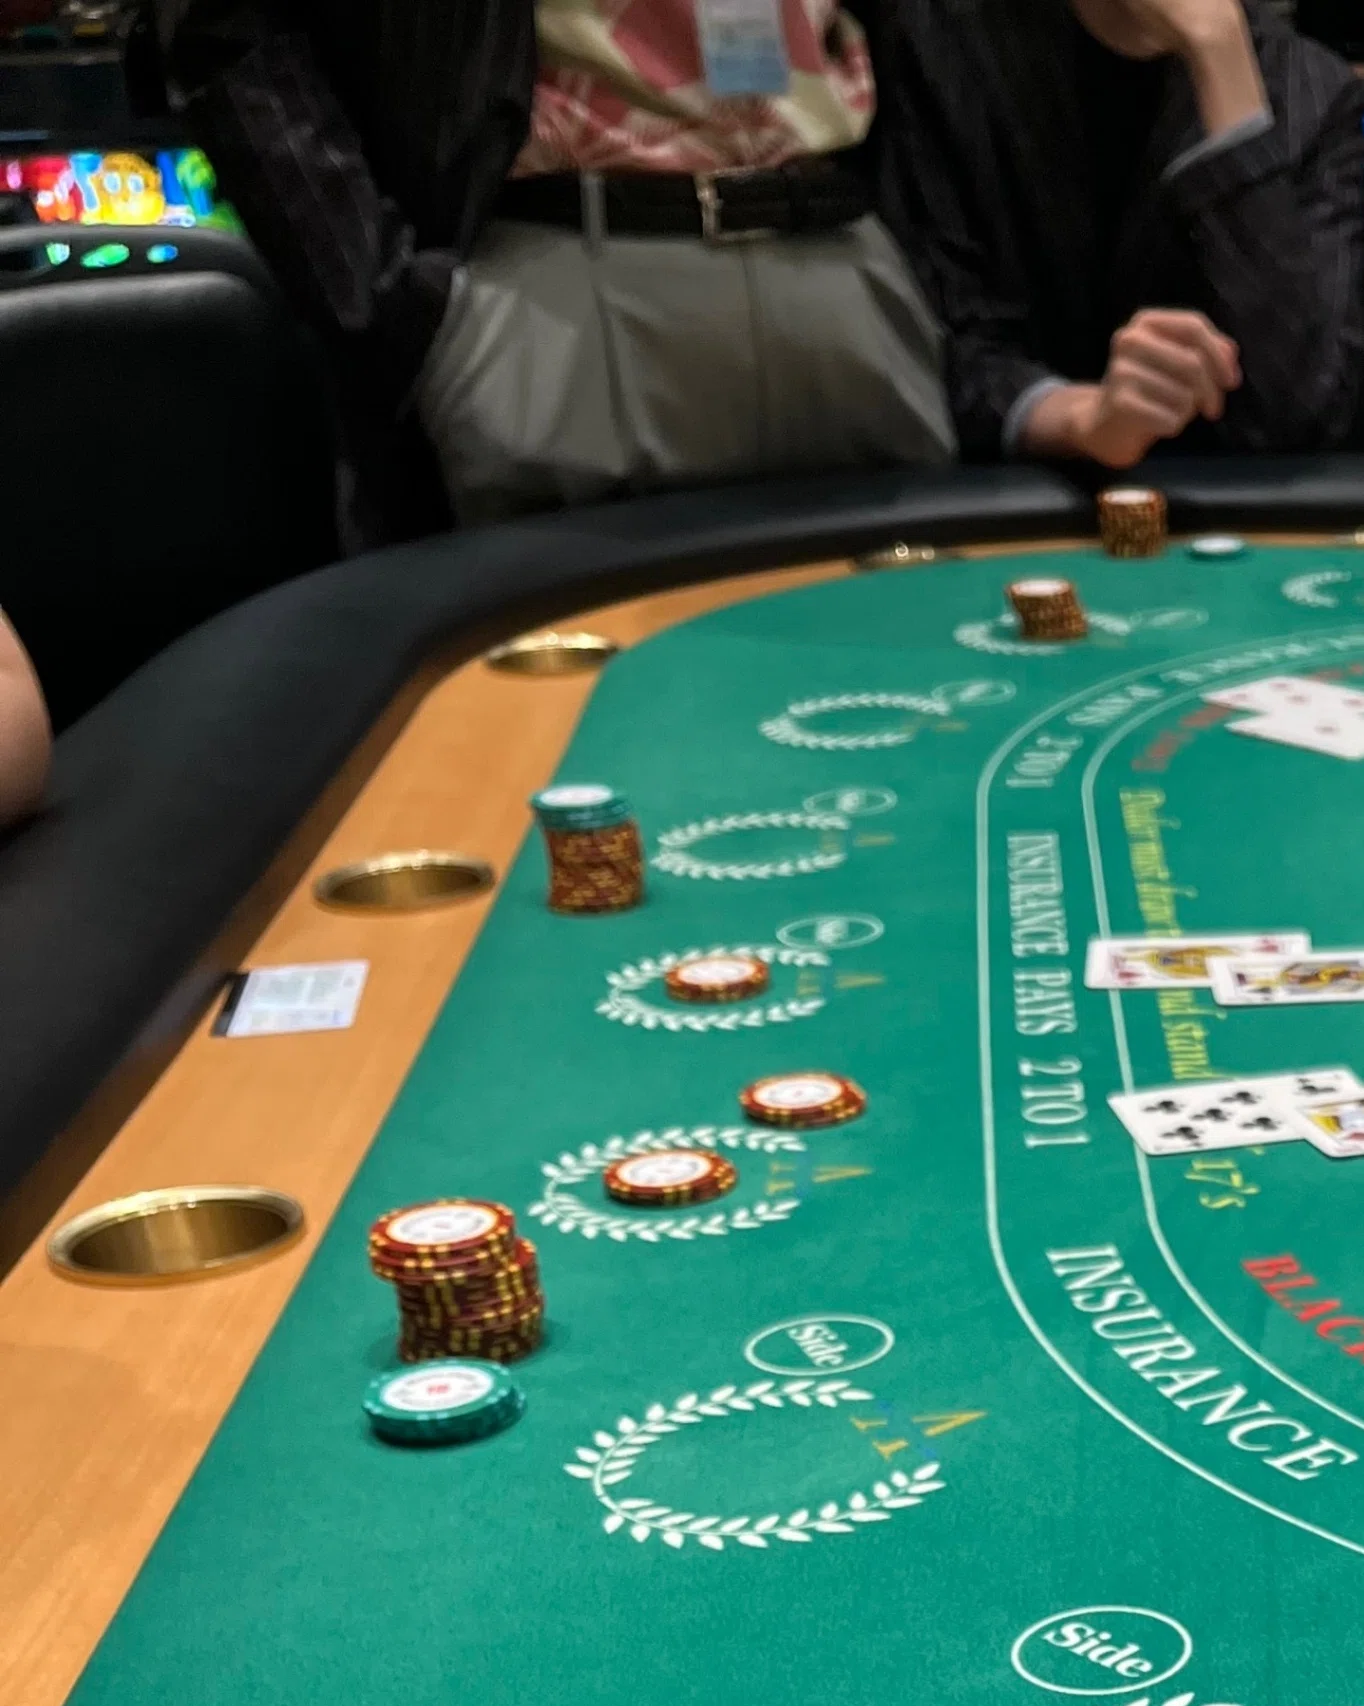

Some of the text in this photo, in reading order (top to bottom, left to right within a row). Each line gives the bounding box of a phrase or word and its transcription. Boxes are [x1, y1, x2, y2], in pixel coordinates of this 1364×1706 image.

[1007, 831, 1090, 1148] INSURANCE PAYS 2 TO 1
[787, 1324, 847, 1367] Side
[1045, 1242, 1359, 1480] INSURANCE
[1042, 1622, 1153, 1678] Side
